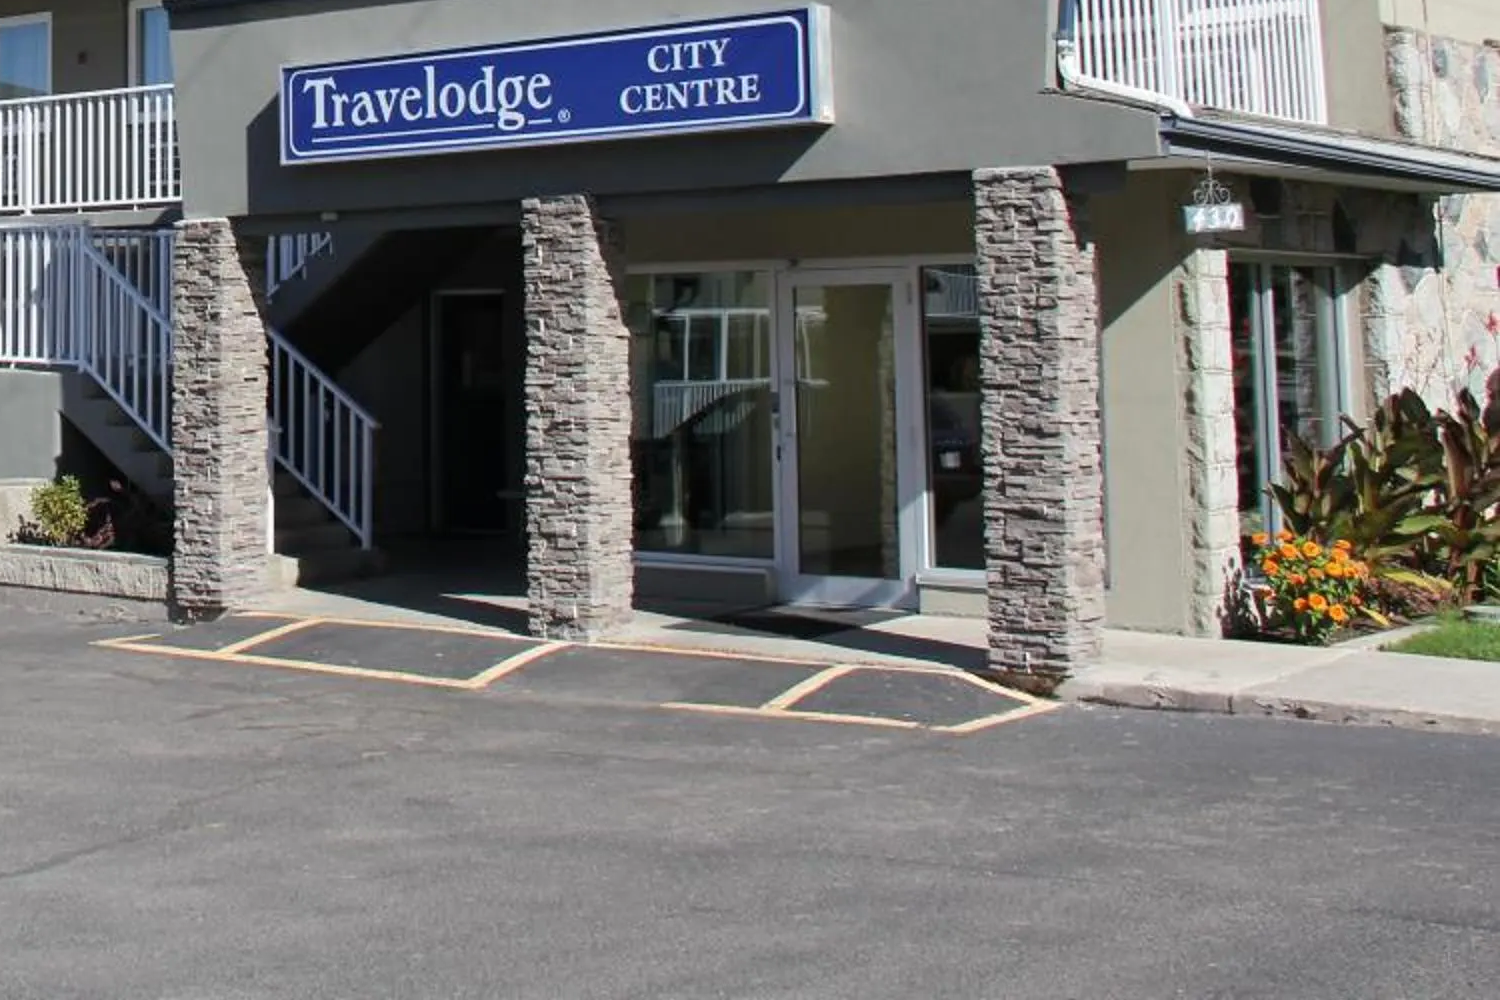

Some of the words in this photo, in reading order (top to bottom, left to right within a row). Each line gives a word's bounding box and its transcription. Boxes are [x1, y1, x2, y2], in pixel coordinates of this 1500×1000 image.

[647, 38, 731, 73] CITY
[303, 65, 551, 131] Travelodge
[619, 74, 761, 114] CENTRE
